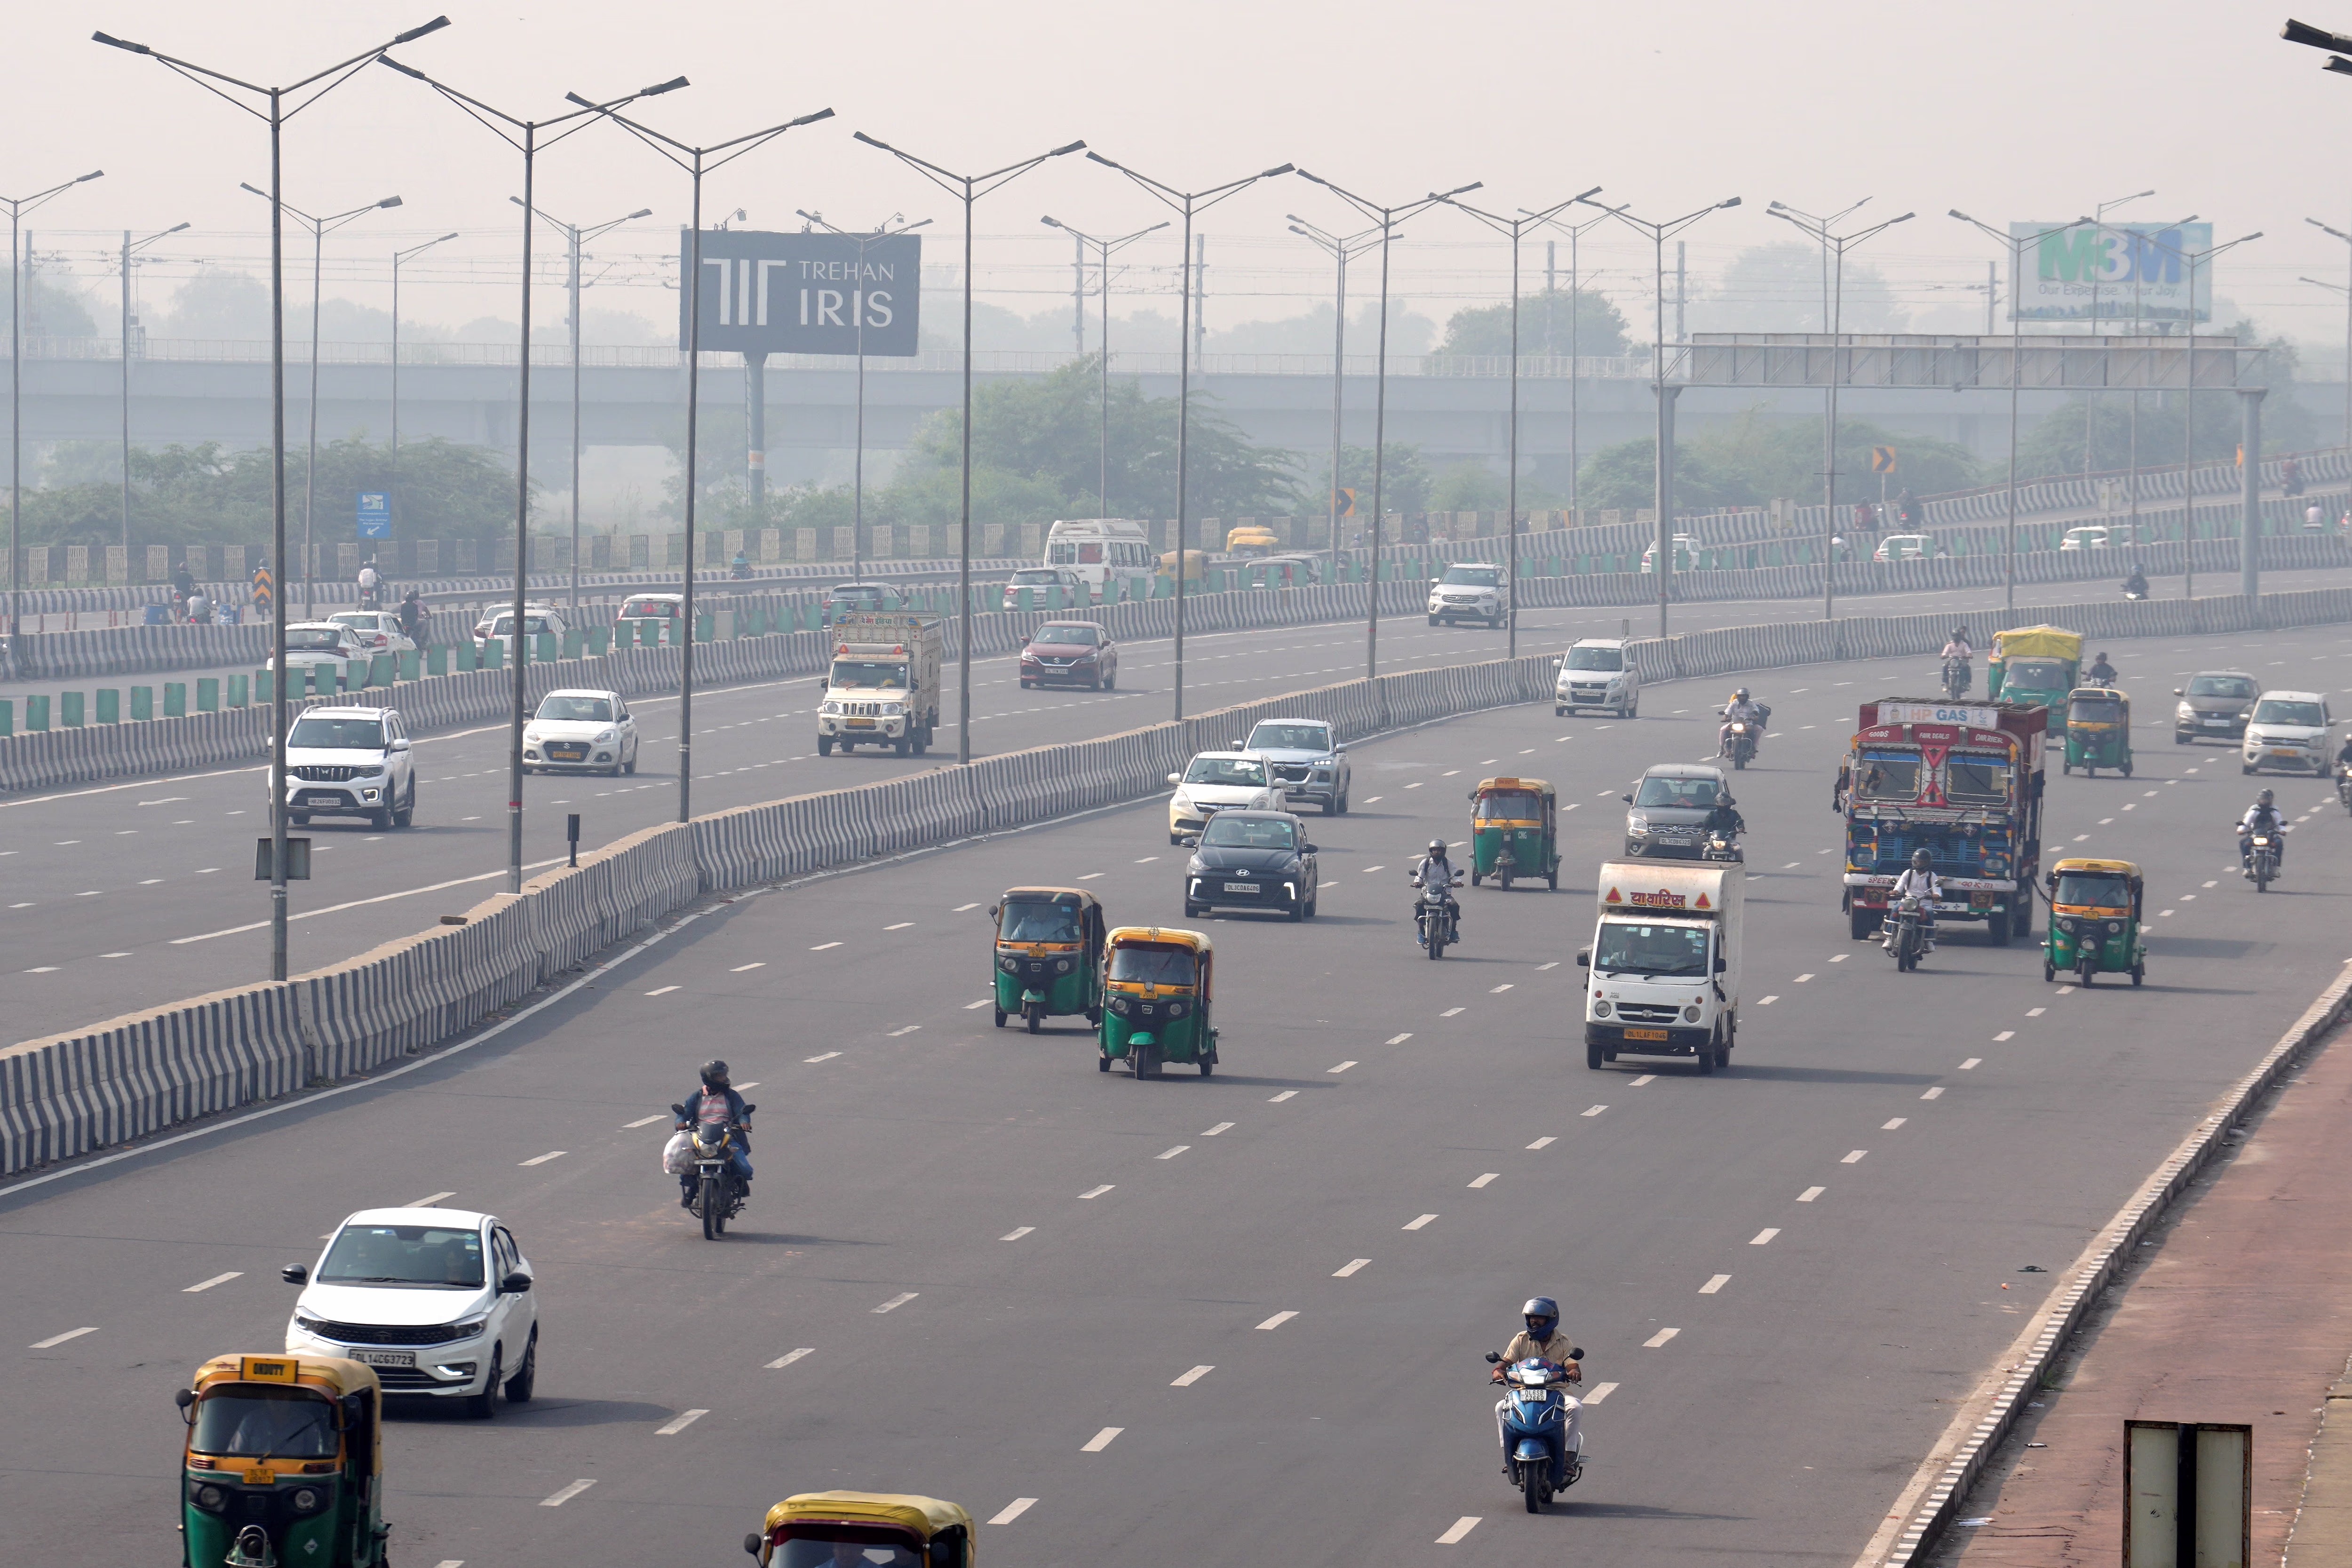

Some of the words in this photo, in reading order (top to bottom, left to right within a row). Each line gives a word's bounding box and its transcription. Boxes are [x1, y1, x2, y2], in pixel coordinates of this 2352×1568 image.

[2039, 229, 2183, 283] M3M
[799, 261, 894, 281] TREHAN
[800, 289, 893, 328] IRIS
[1911, 709, 1932, 720] HP
[1936, 709, 1968, 721] GAS
[1975, 733, 2004, 744] CARRIER
